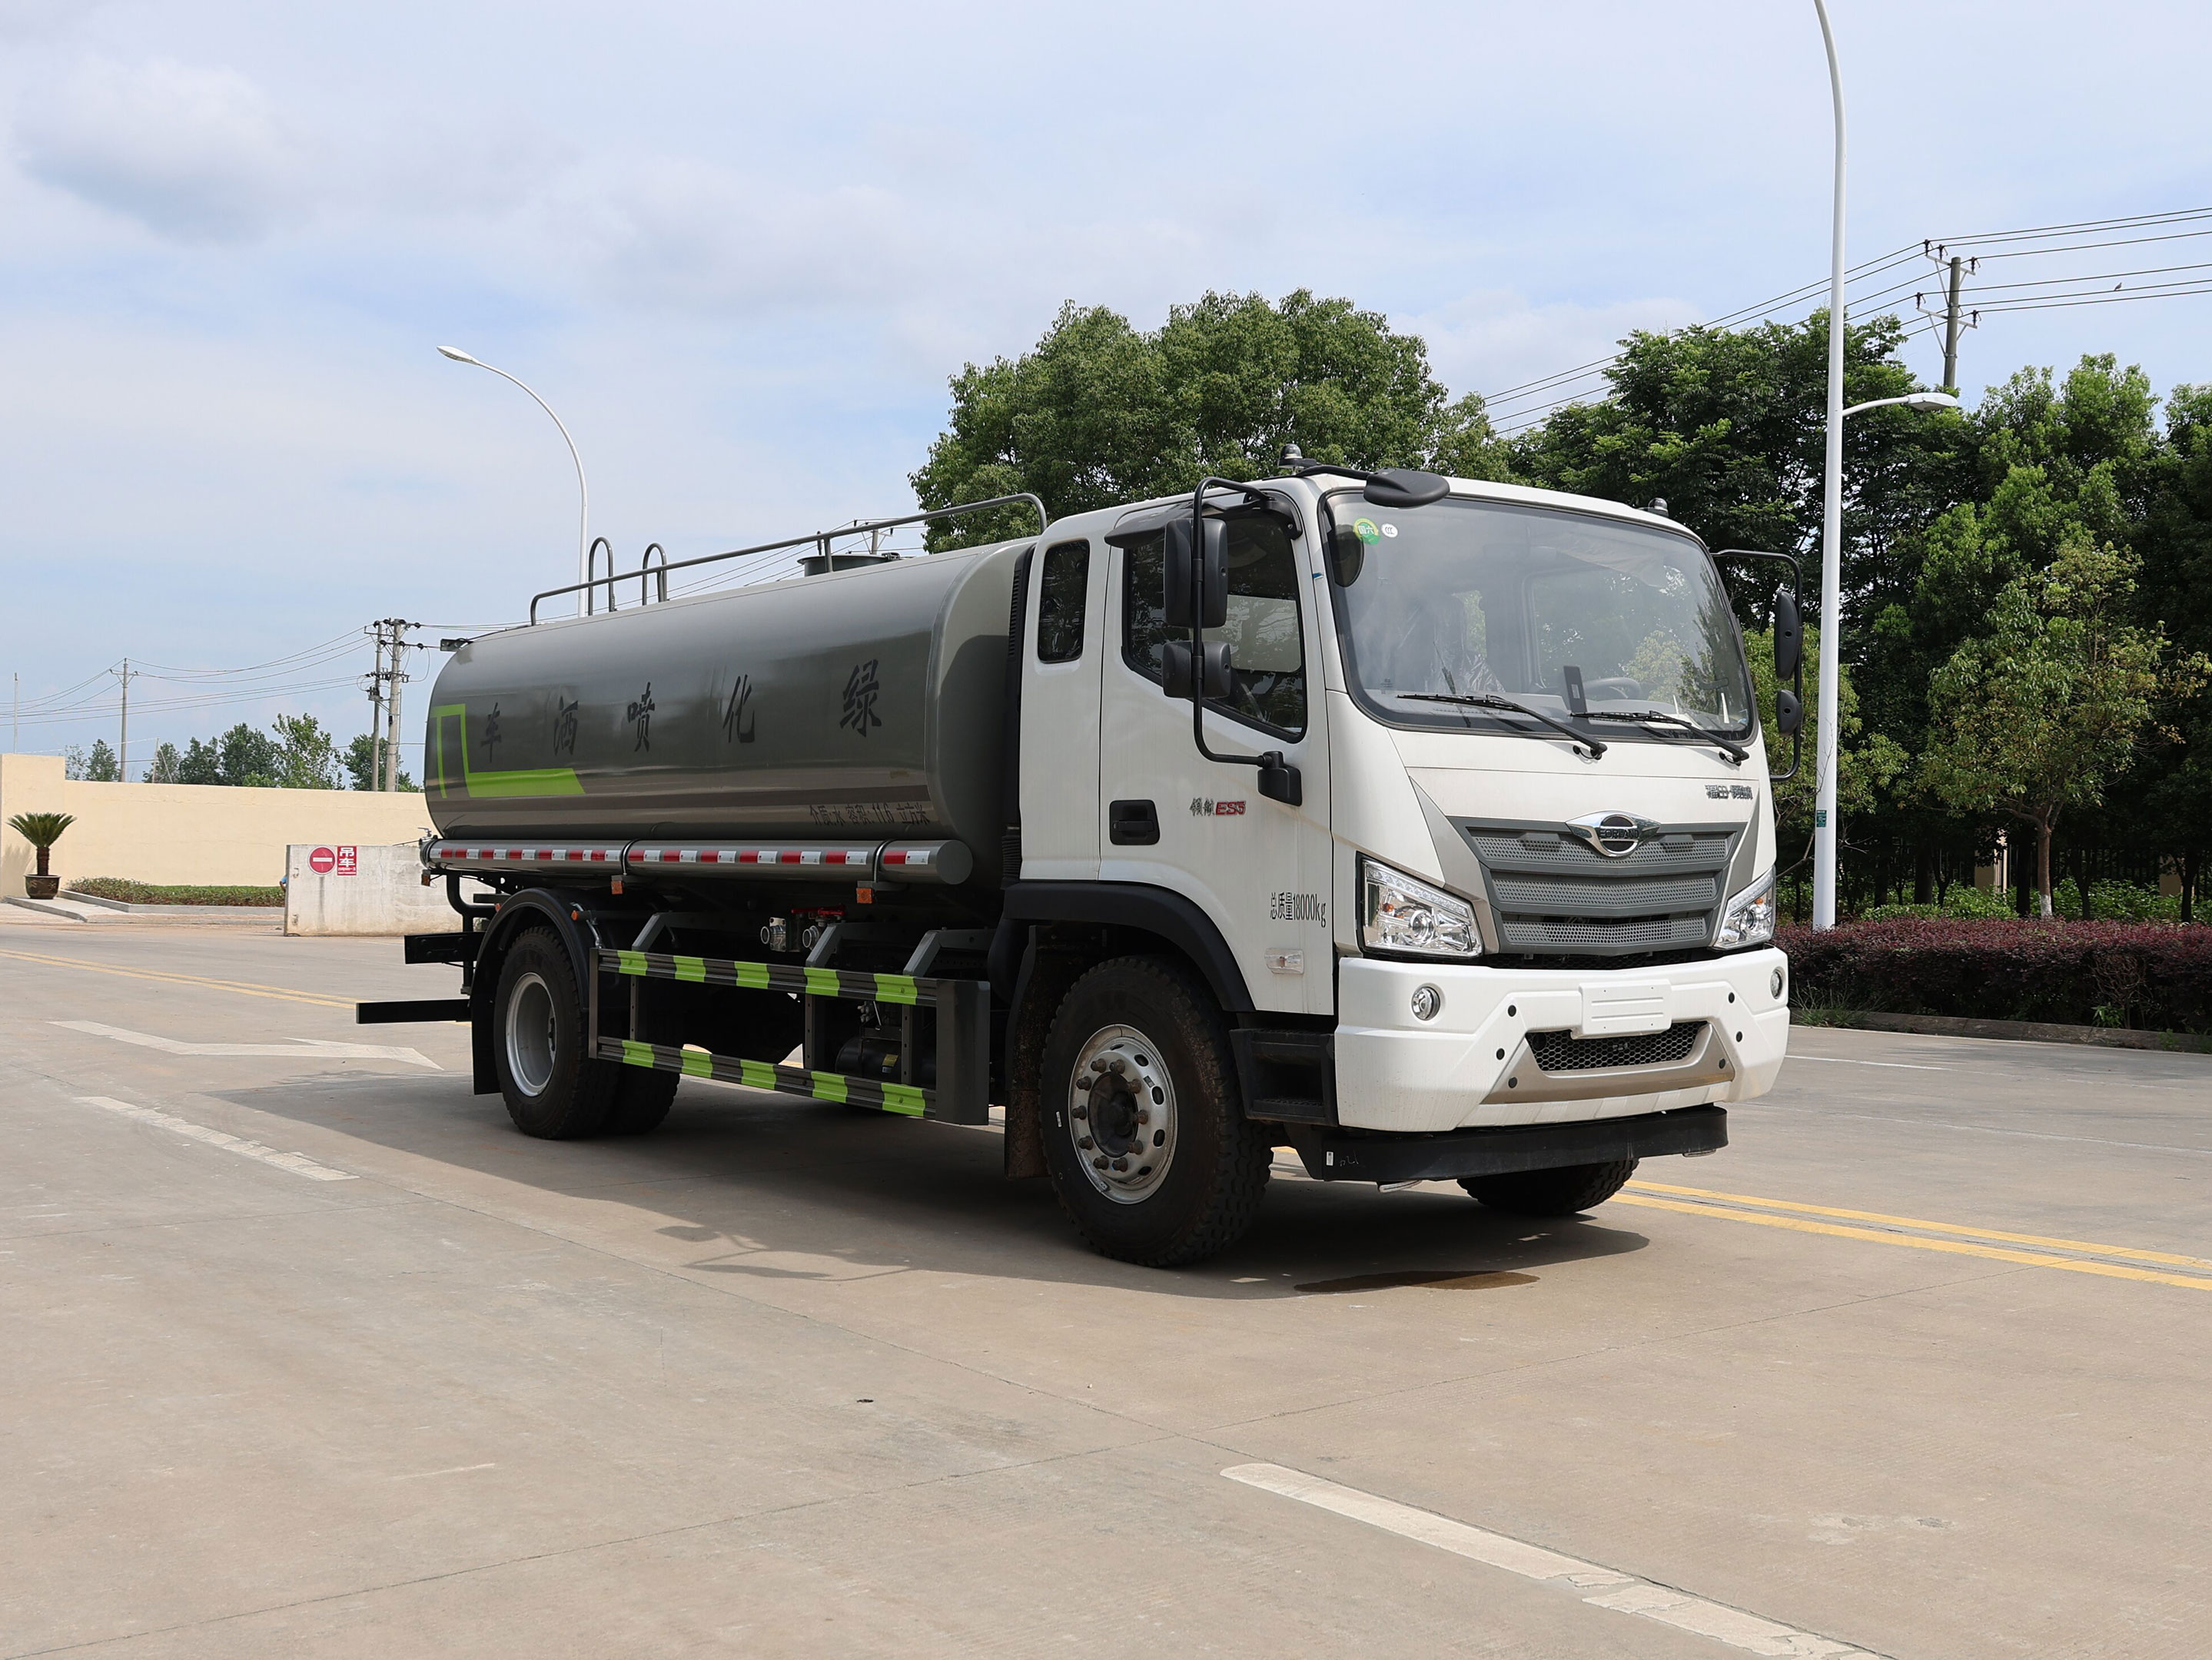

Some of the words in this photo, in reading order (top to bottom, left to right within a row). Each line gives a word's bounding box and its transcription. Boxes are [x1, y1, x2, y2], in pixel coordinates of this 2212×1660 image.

[338, 847, 356, 868] 吊车
[1270, 892, 1326, 928] 总质量18000kg
